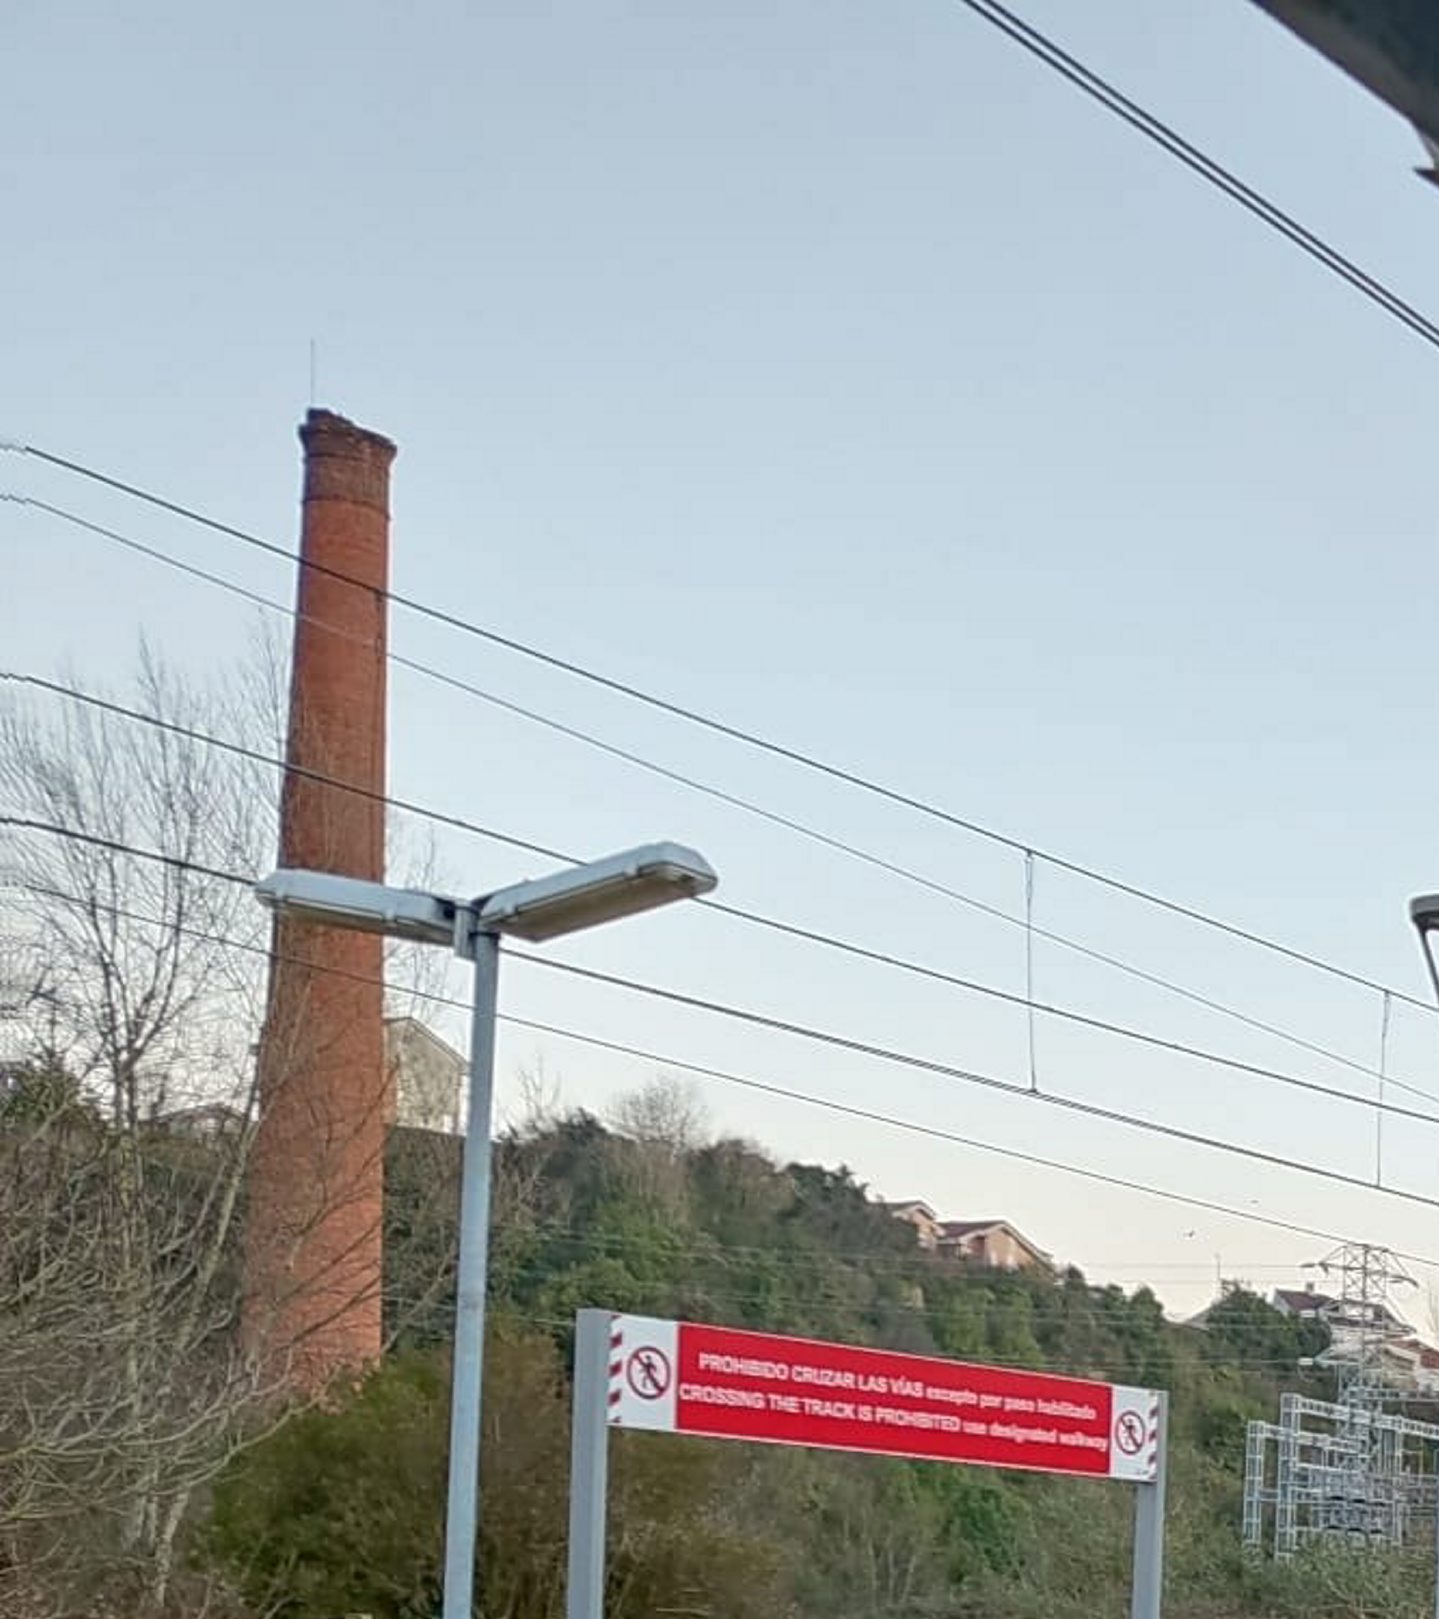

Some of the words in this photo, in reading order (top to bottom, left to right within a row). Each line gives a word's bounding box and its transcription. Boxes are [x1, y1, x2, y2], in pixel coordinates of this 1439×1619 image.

[680, 1383, 765, 1409] CROSSING
[767, 1393, 801, 1413] THE
[804, 1397, 855, 1419] TRACK
[858, 1404, 873, 1422] IS
[876, 1407, 961, 1431] PROHIBITED
[989, 1421, 1057, 1443] designated
[1059, 1431, 1109, 1453] walkway
[698, 1352, 788, 1380] PROHIBIDO
[791, 1365, 855, 1389] CRUZAR
[857, 1374, 887, 1392] LAS
[889, 1375, 923, 1398] VÍAS
[1037, 1399, 1097, 1420] habilitado
